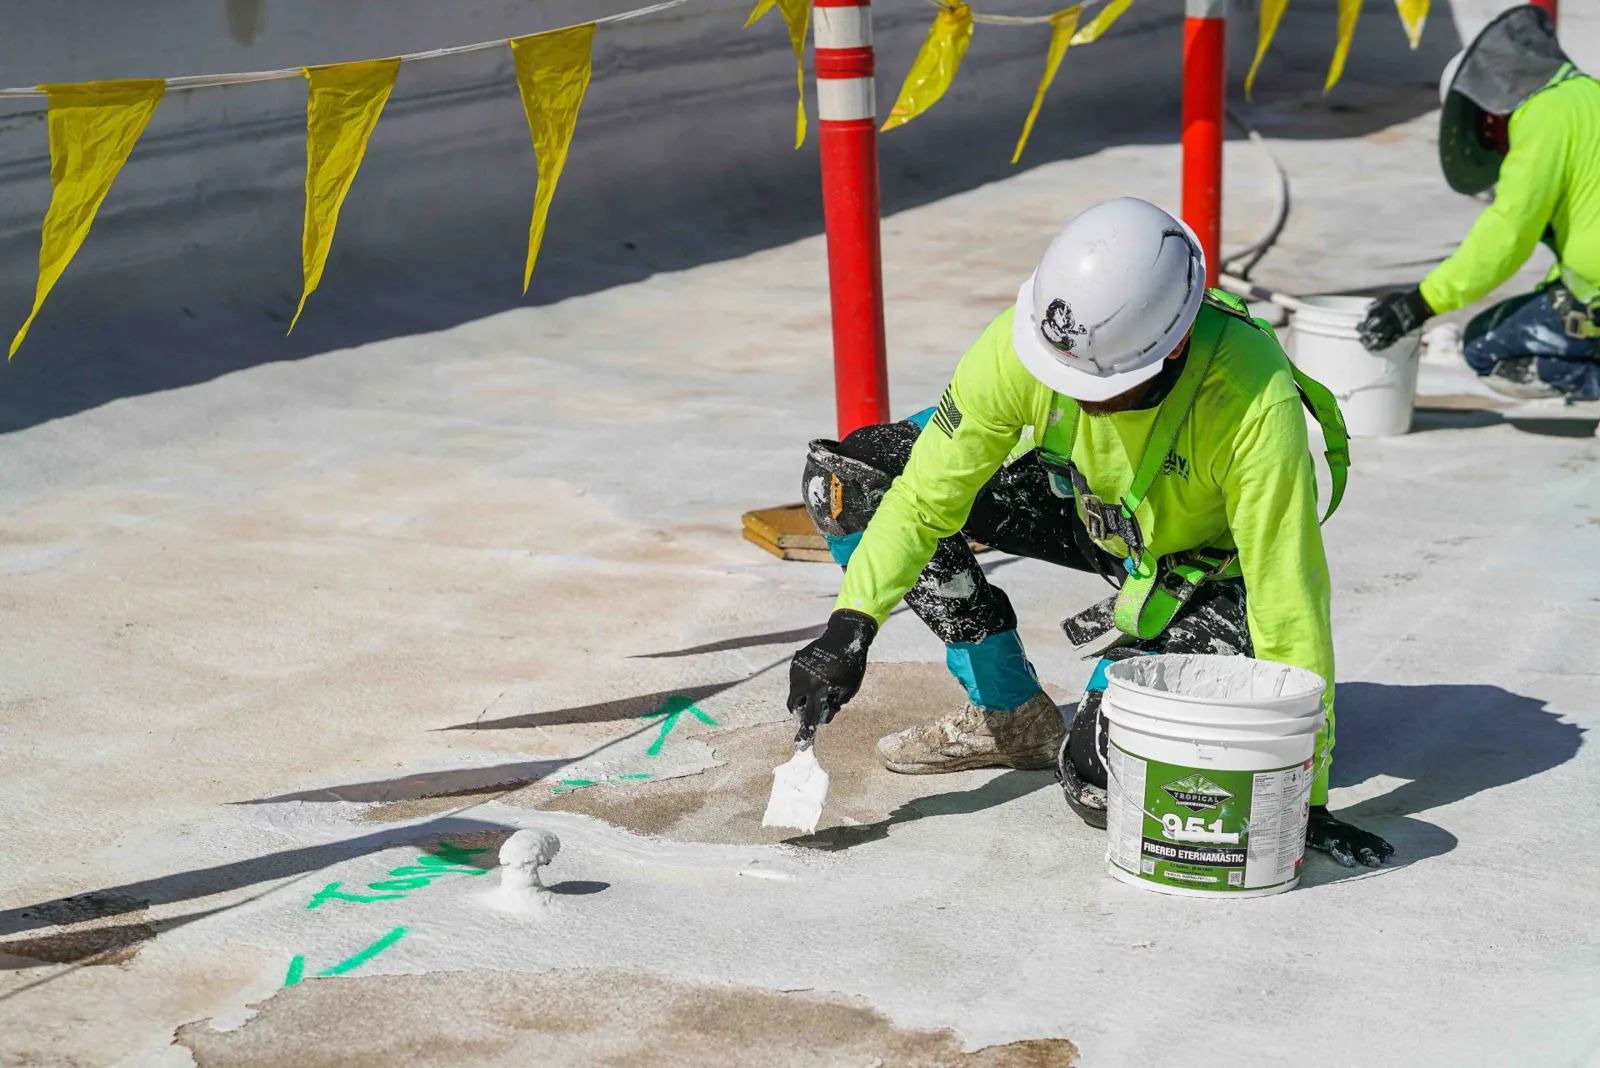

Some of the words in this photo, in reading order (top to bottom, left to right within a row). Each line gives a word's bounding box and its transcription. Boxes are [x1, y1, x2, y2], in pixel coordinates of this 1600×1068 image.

[1173, 792, 1219, 803] TROPICAL
[1162, 813, 1223, 844] 951
[1143, 841, 1177, 857] FIBERED
[1178, 849, 1245, 863] ETERNAMASTIC
